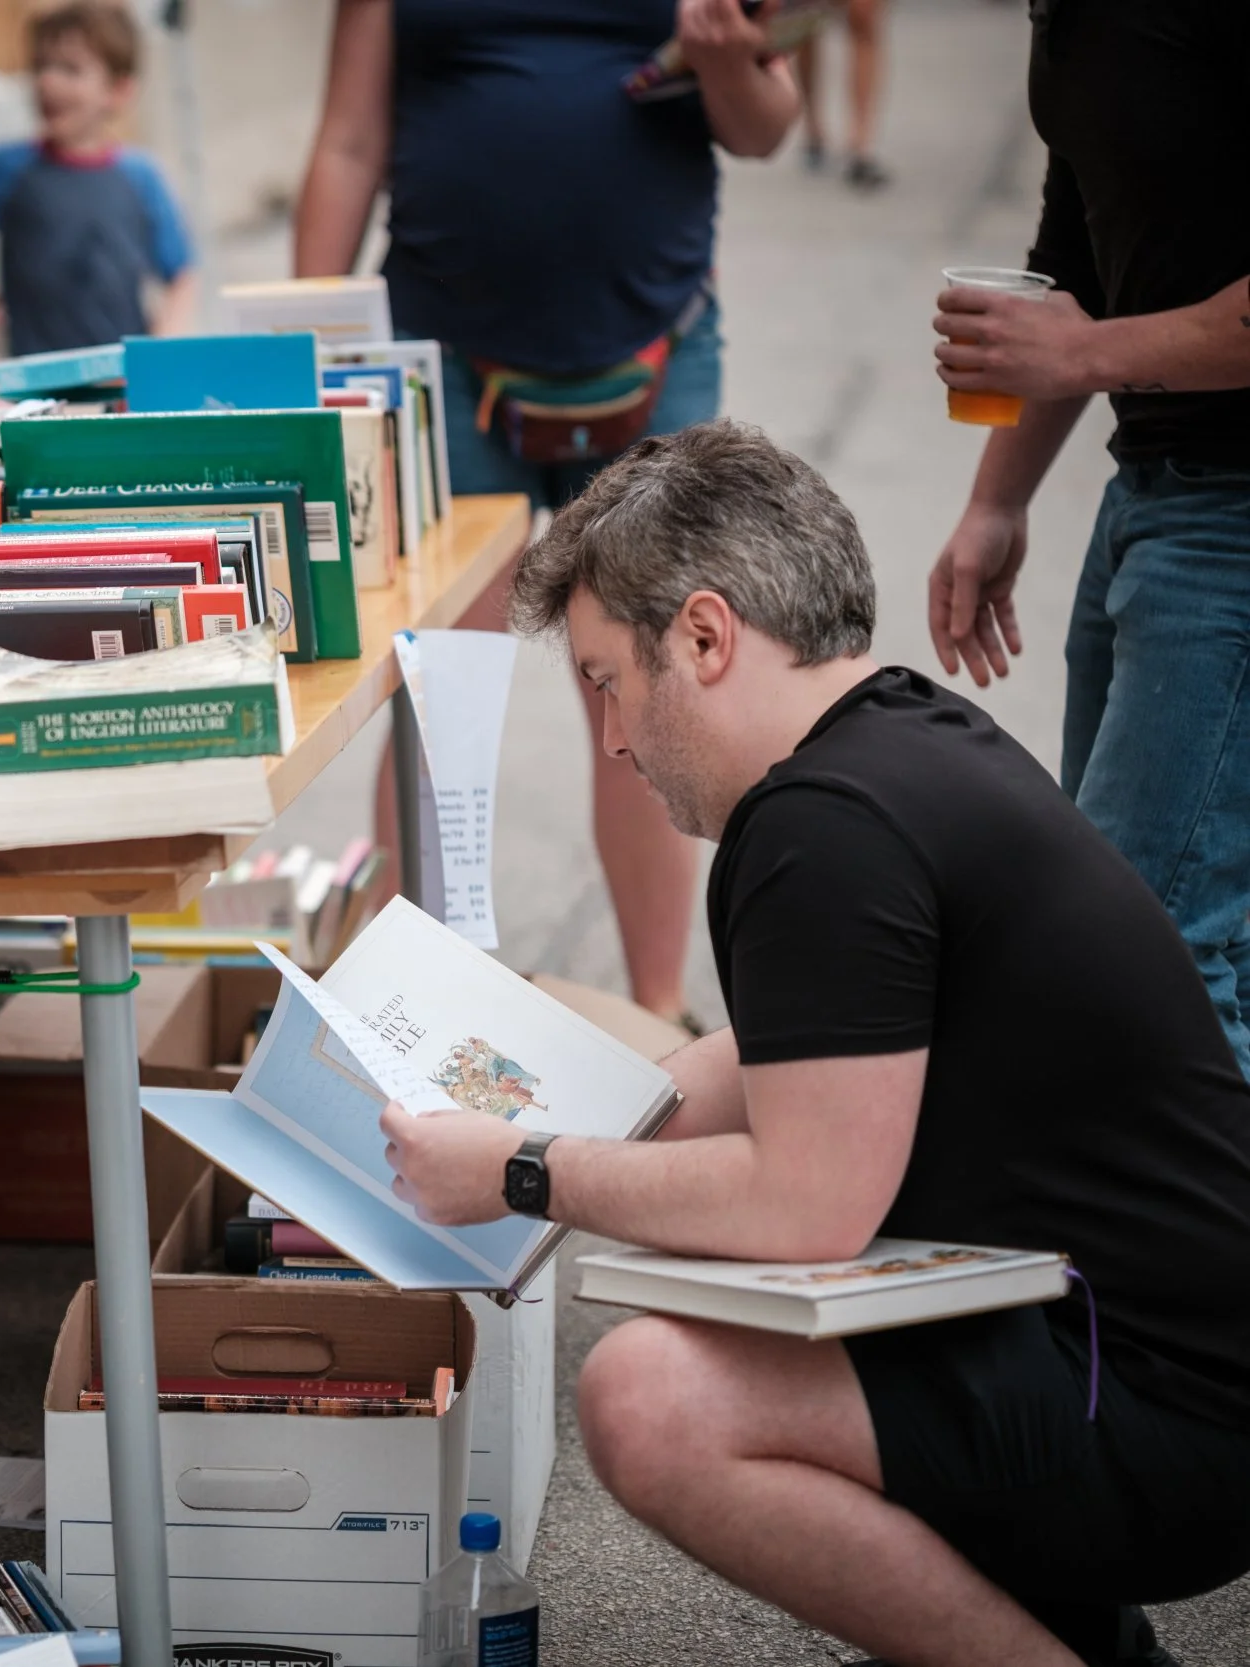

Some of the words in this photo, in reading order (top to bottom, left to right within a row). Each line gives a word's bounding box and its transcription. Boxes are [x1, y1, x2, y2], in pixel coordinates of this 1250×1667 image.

[37, 712, 67, 728] THE
[69, 707, 135, 726] NORTON
[140, 701, 236, 719] ANTHOLOGY
[45, 726, 66, 742] OF
[70, 721, 135, 741] ENGLISH
[139, 715, 228, 737] LITERATURE
[269, 1271, 298, 1280] Christ
[389, 1520, 419, 1531] 713
